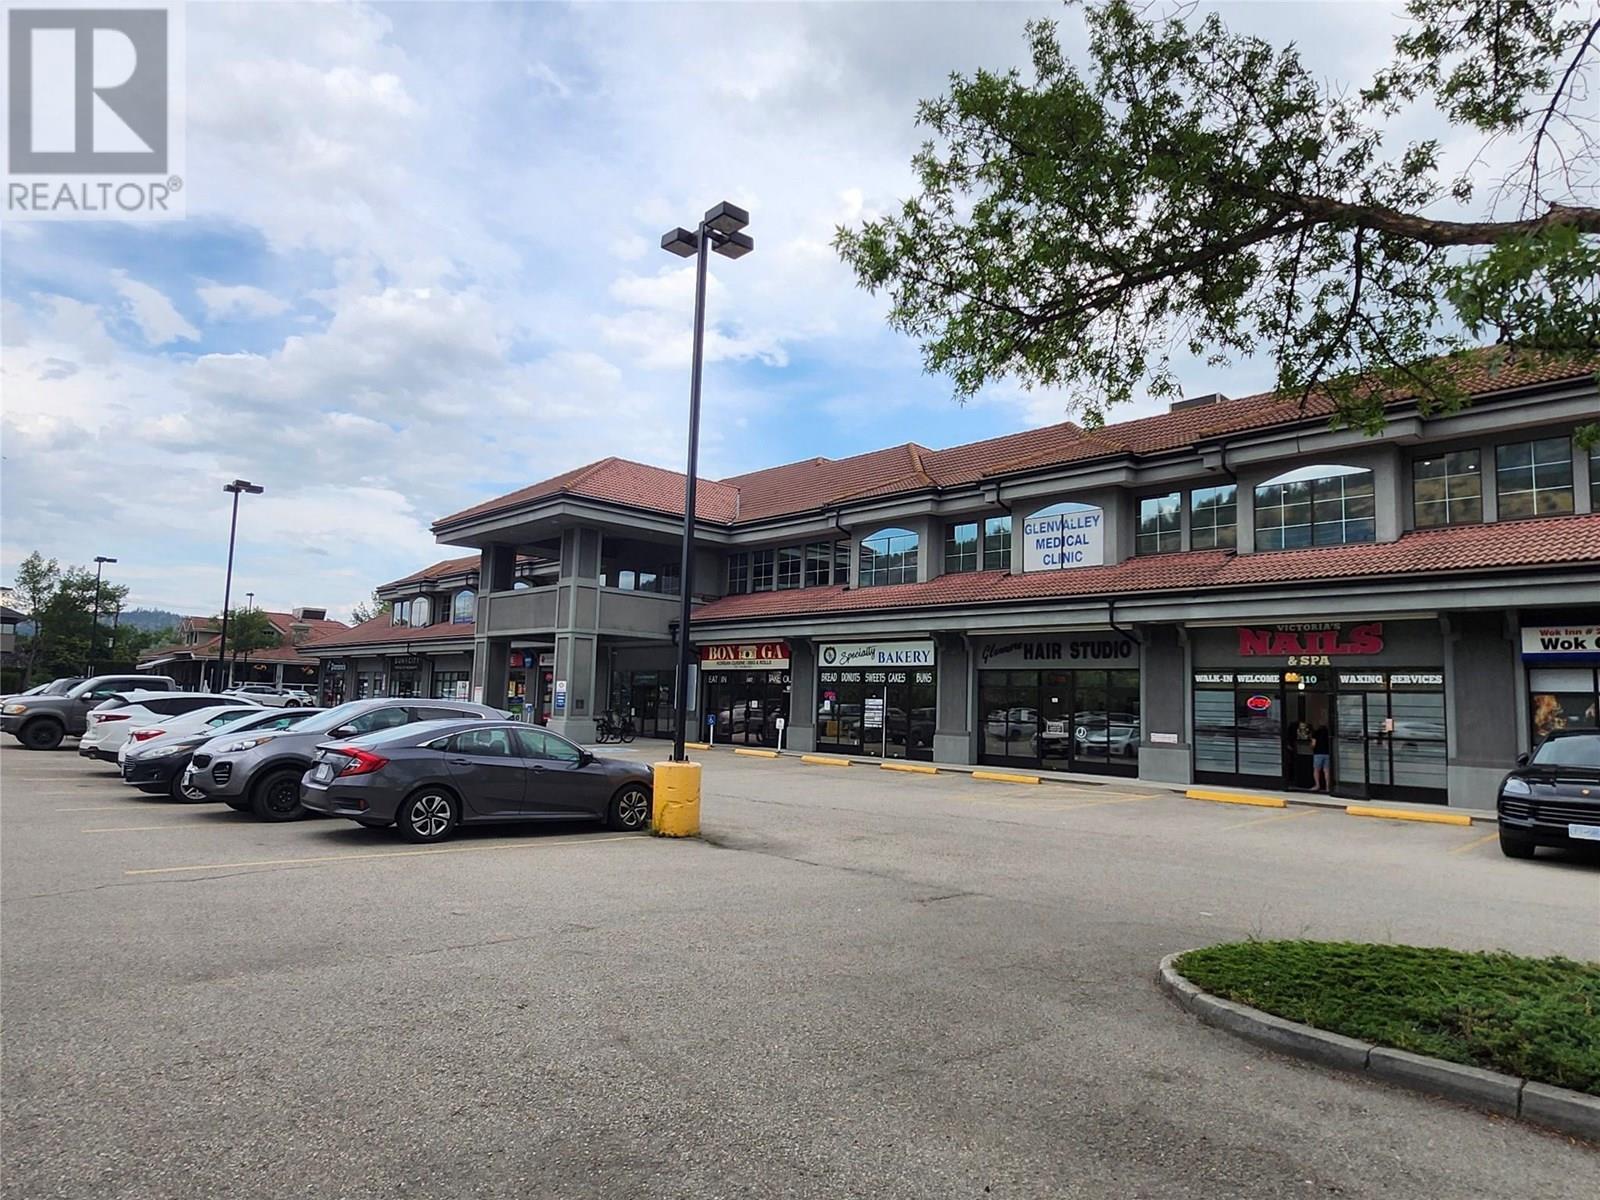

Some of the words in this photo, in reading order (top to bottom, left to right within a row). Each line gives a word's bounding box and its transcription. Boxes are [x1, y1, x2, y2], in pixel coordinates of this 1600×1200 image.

[1024, 515, 1100, 535] GLENVALLEY
[1035, 534, 1089, 550] MEDICAL
[1043, 551, 1083, 566] CLINIC
[1277, 622, 1341, 631] VICTORIA'S
[1565, 628, 1582, 636] Inn
[1238, 623, 1384, 656] NAILS
[1541, 637, 1587, 650] Wok
[708, 645, 735, 660] BON
[761, 644, 783, 659] GA
[840, 645, 878, 665] Specialty
[878, 650, 930, 663] BAKERY
[1023, 642, 1062, 660] HAIR
[1070, 640, 1132, 658] STUDIO
[1288, 656, 1297, 666] &
[1299, 656, 1330, 666] SPA
[708, 675, 718, 683] EAT
[821, 673, 837, 682] BREAD
[841, 673, 861, 682] DONUTS
[865, 673, 886, 682] SWEETS
[888, 673, 906, 682] CAKES
[916, 673, 932, 683] BUNS
[1195, 675, 1233, 683] WALK-IN
[1237, 675, 1280, 683] WELCOME
[1340, 675, 1383, 684] WAXING
[1390, 675, 1442, 684] SERVICES
